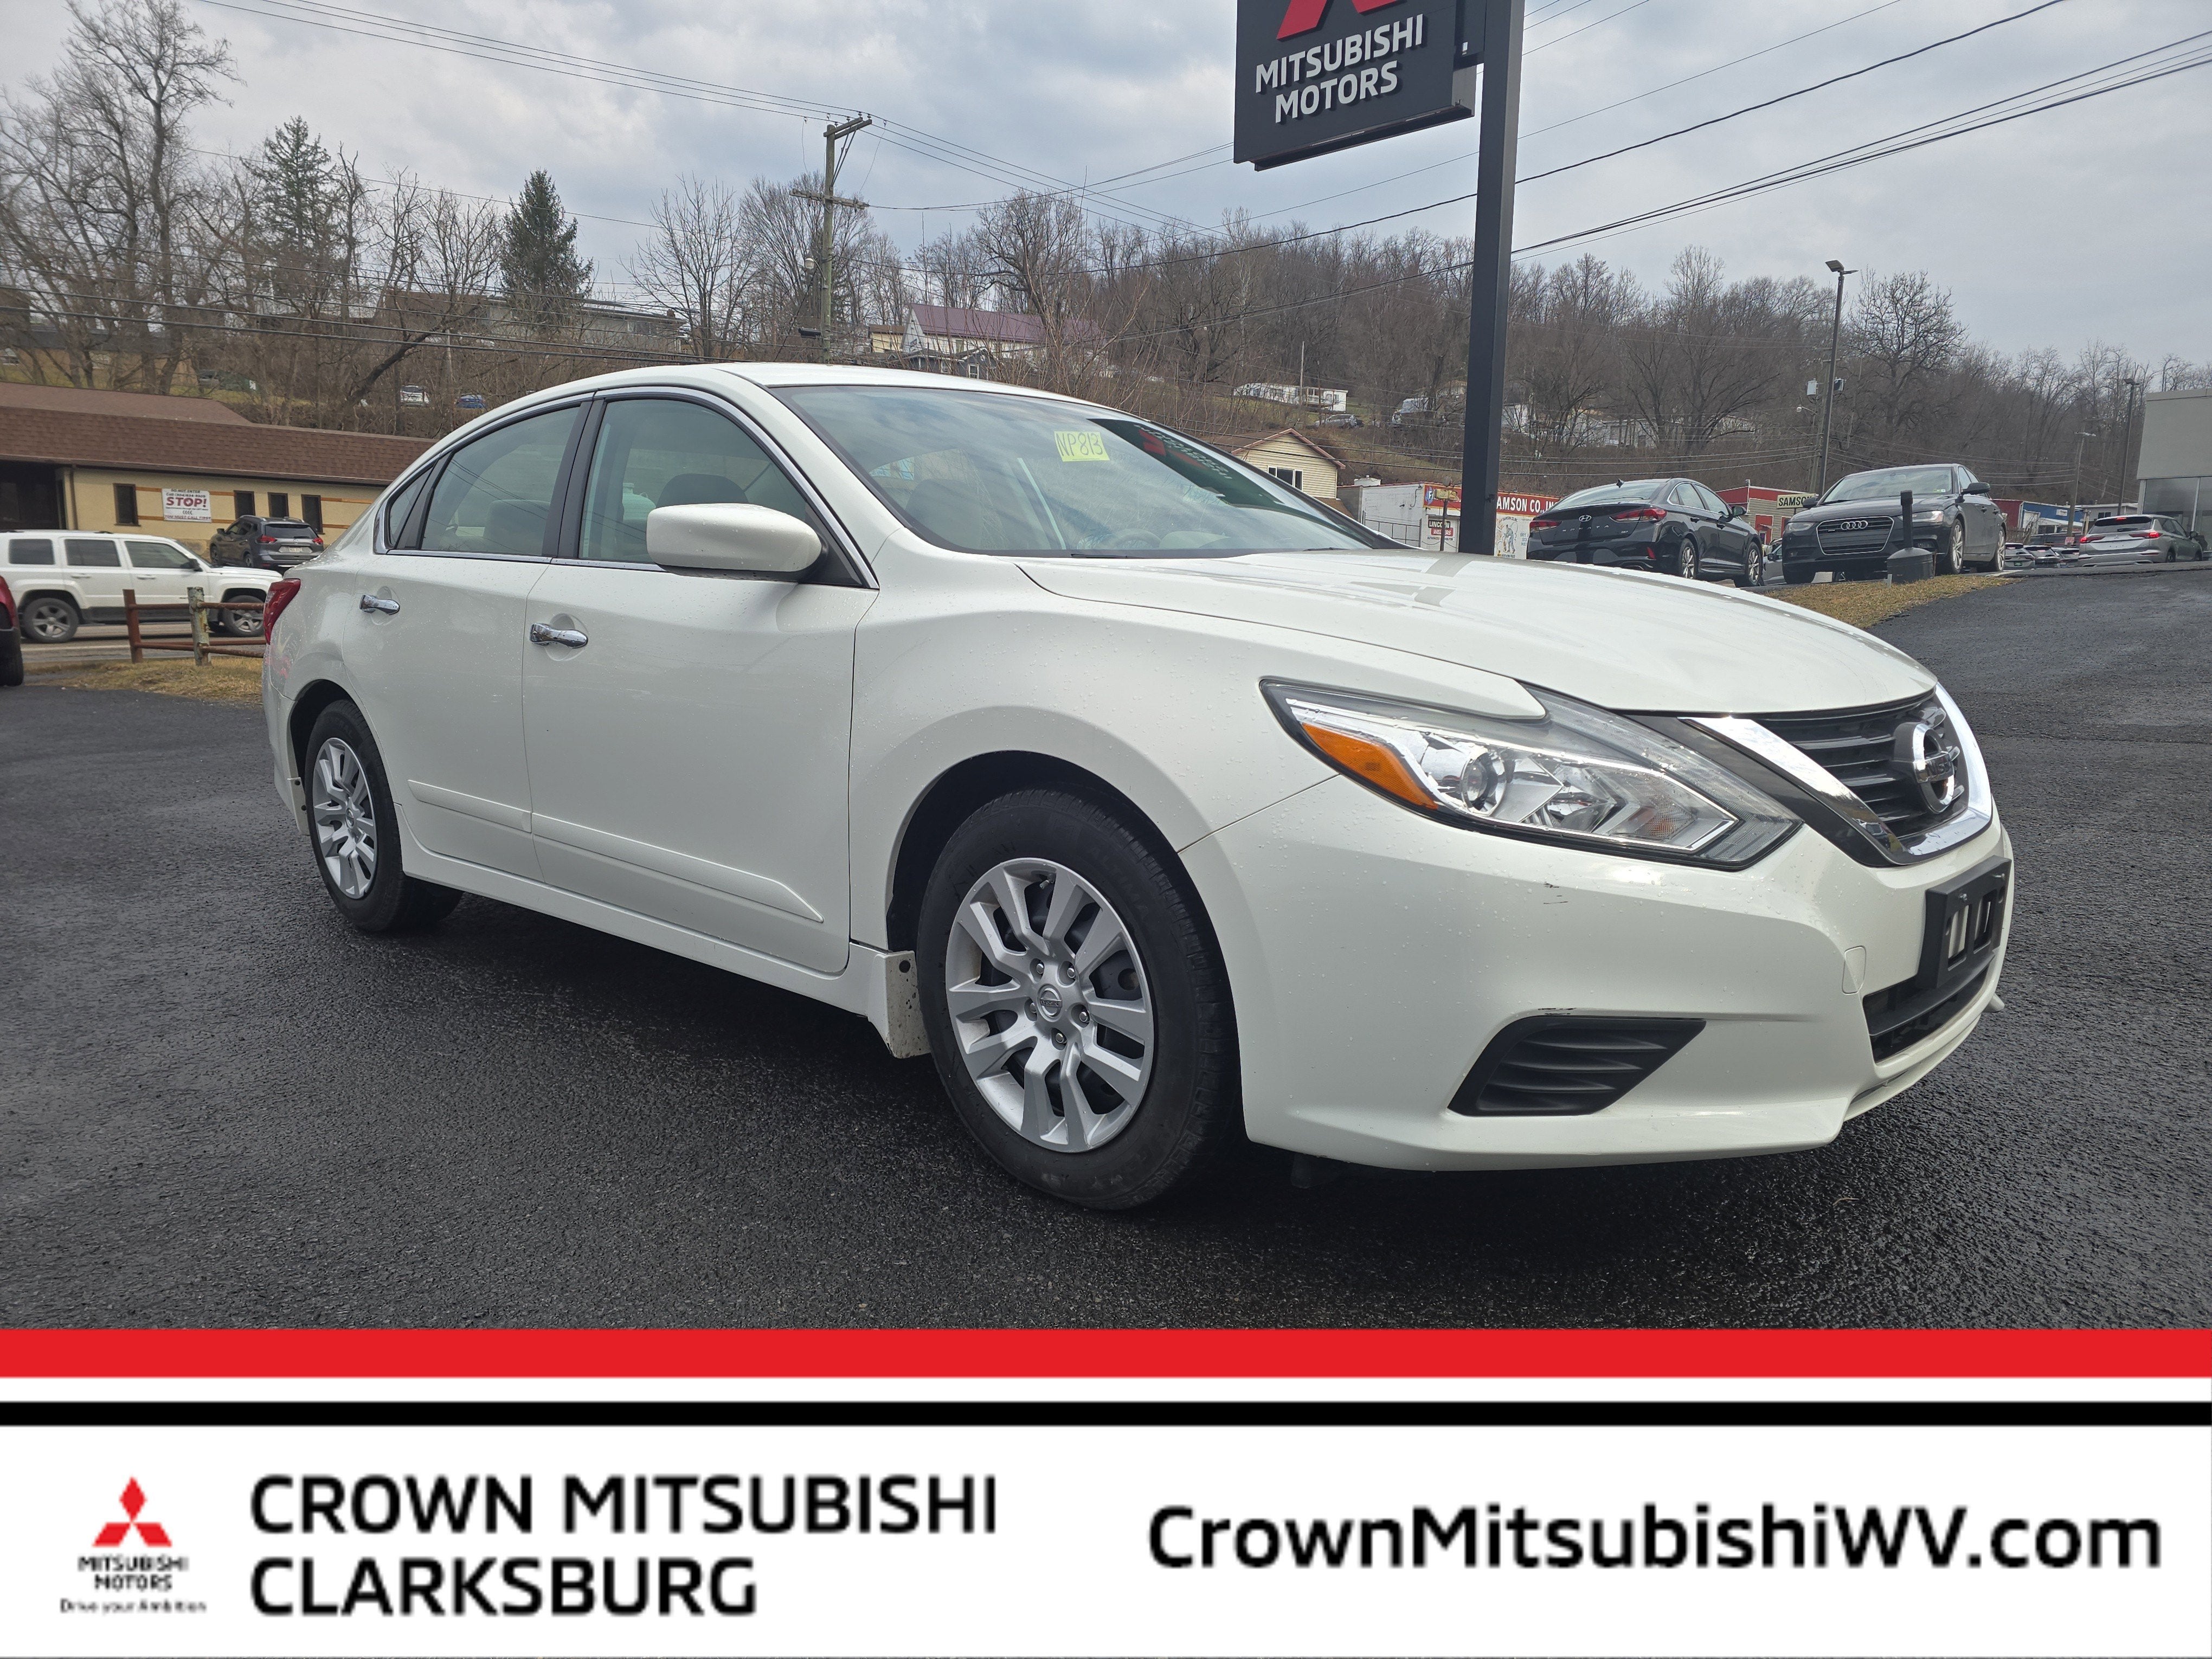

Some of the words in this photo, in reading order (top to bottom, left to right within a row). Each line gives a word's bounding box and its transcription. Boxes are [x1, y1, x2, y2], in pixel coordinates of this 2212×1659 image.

[1256, 14, 1423, 93] MITSUBISHI
[1276, 60, 1397, 123] MOTORS
[1056, 432, 1103, 456] NP813
[166, 497, 207, 507] STOP!
[1496, 496, 1527, 512] AMSON
[1779, 496, 1812, 506] SAMSO
